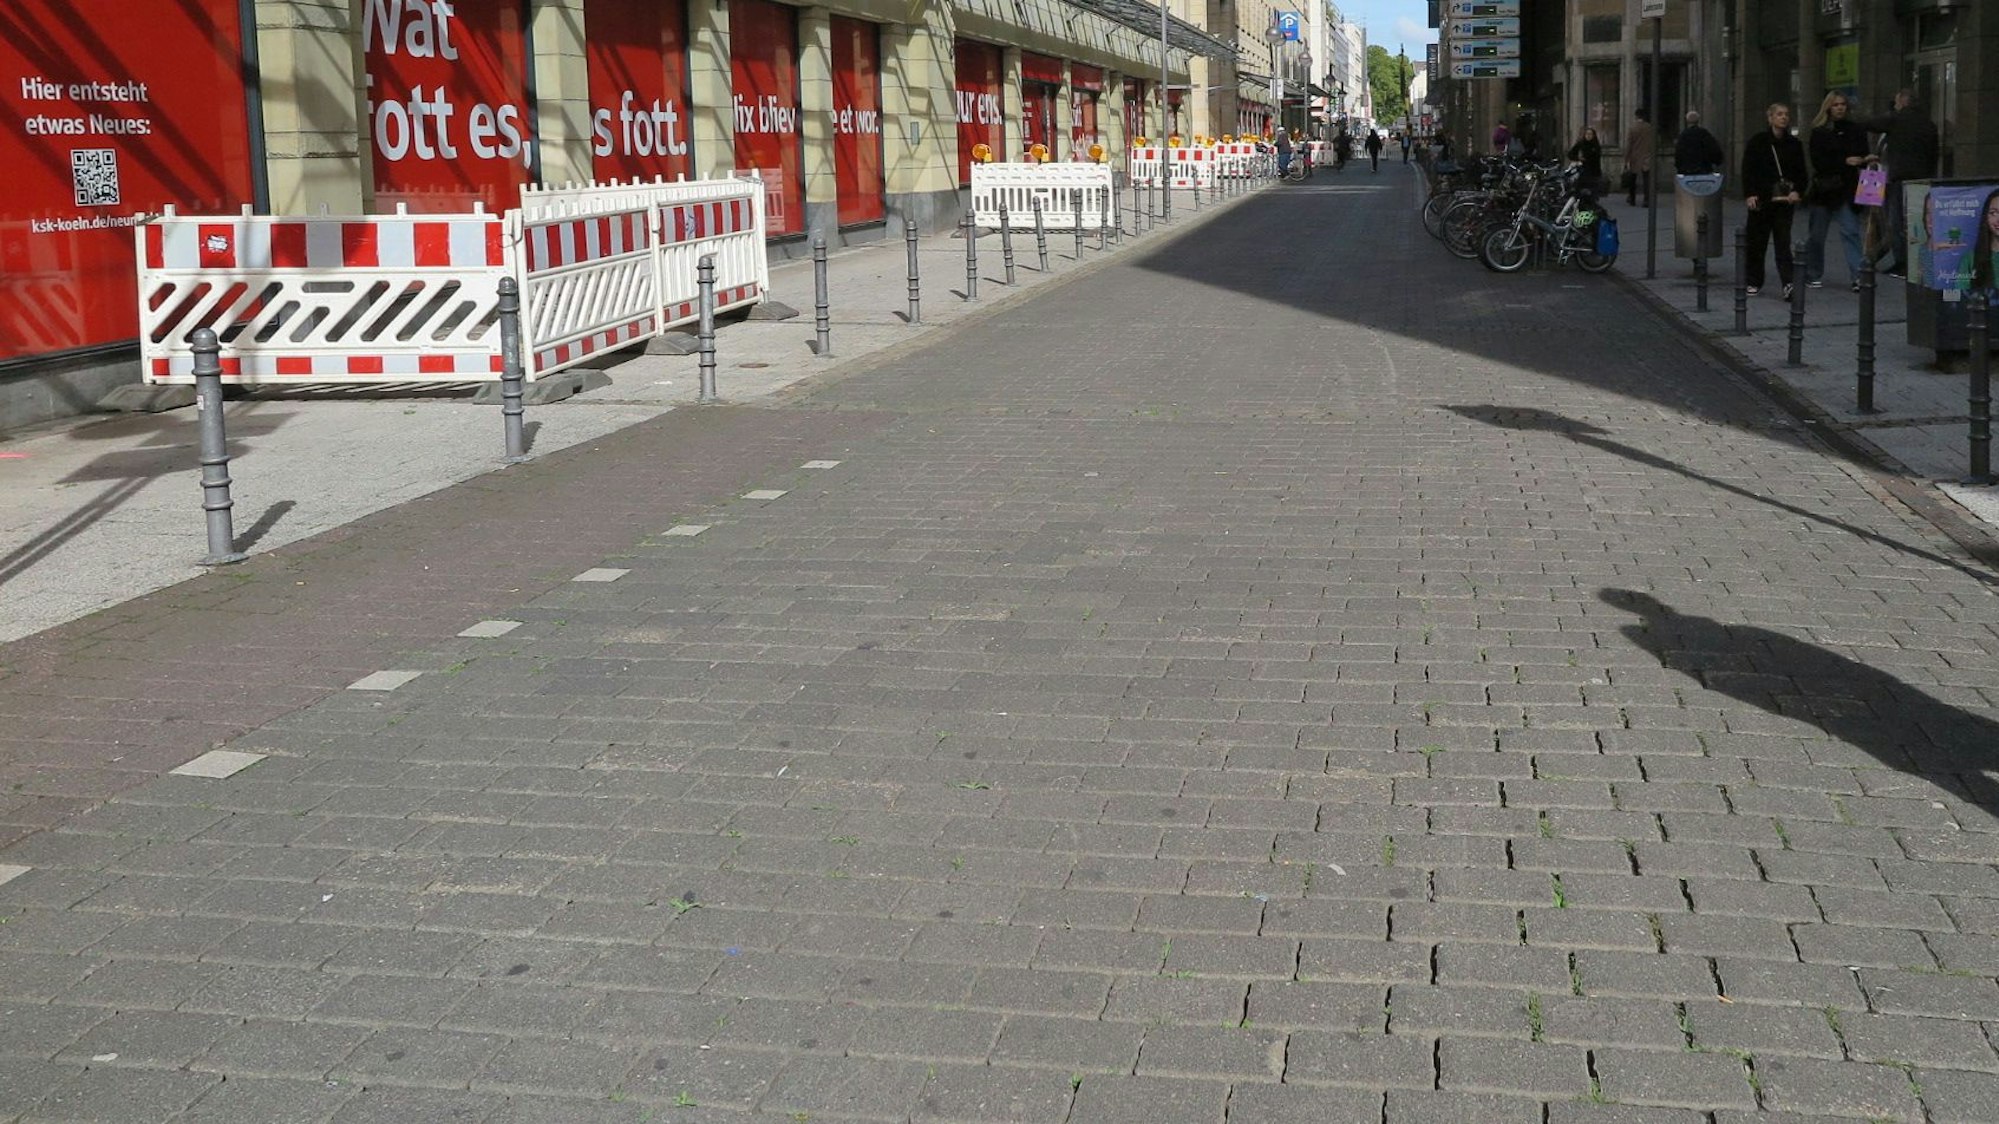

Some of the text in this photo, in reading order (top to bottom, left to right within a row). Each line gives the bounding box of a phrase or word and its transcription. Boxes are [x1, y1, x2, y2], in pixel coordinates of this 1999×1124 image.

[1286, 19, 1293, 28] P
[21, 77, 148, 102] Hier entsteht
[25, 113, 151, 135] etwas Neues:
[366, 74, 532, 169] ott es,
[591, 90, 687, 157] s fott.
[758, 94, 795, 133] bliev
[840, 104, 853, 133] et
[856, 110, 879, 133] wor.
